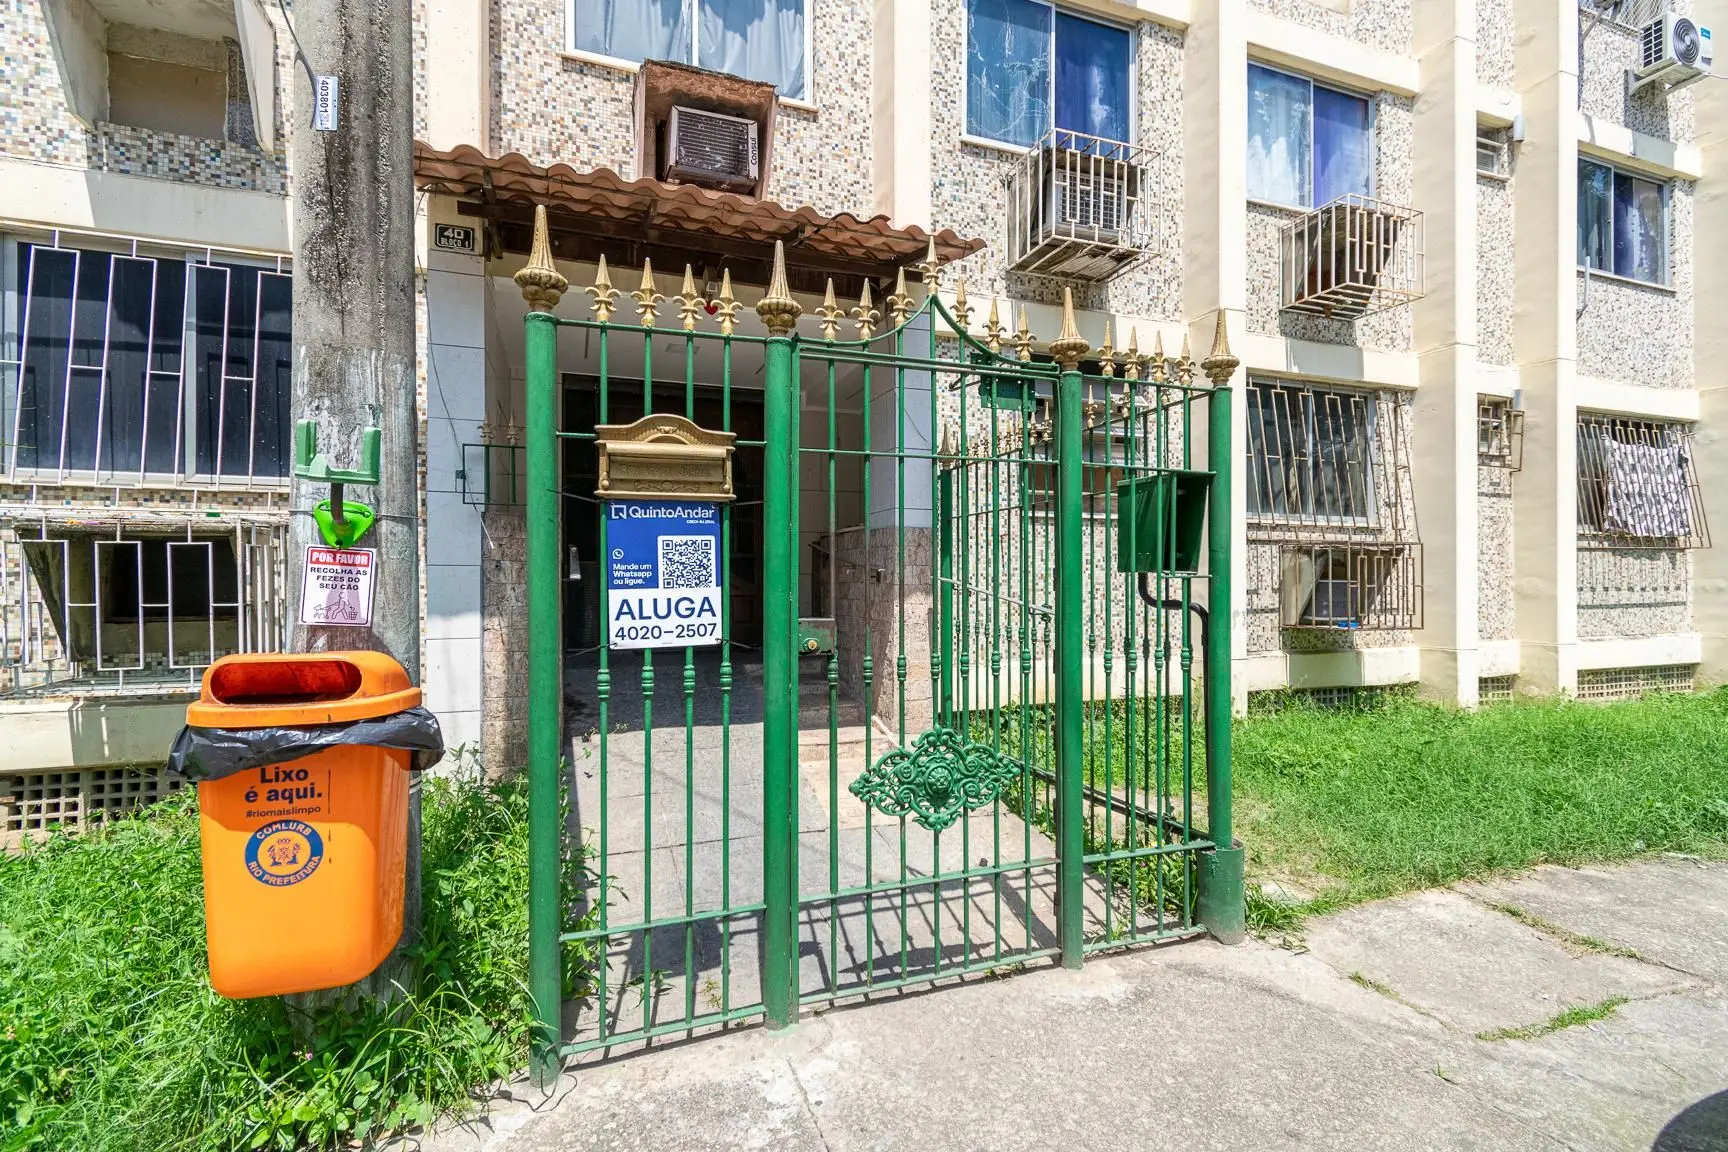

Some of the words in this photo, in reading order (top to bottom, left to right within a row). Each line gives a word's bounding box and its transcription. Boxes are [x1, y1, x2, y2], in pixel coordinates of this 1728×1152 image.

[320, 80, 329, 113] 403801
[443, 228, 464, 239] 40
[629, 506, 714, 519] QuintoAndar
[312, 552, 334, 563] POR
[335, 554, 369, 565] FAVOR
[316, 575, 345, 583] FEZES
[613, 570, 652, 579] Whatsapp
[615, 596, 717, 621] ALUGA
[615, 623, 717, 641] 4020-2507
[260, 766, 309, 784] Lixo
[244, 786, 258, 803] é
[266, 782, 322, 804] aqui.
[246, 806, 321, 818] #riomaislimpo
[256, 821, 312, 840] COMLURB
[248, 861, 262, 877] RIO
[262, 855, 321, 885] PREFEITURA
